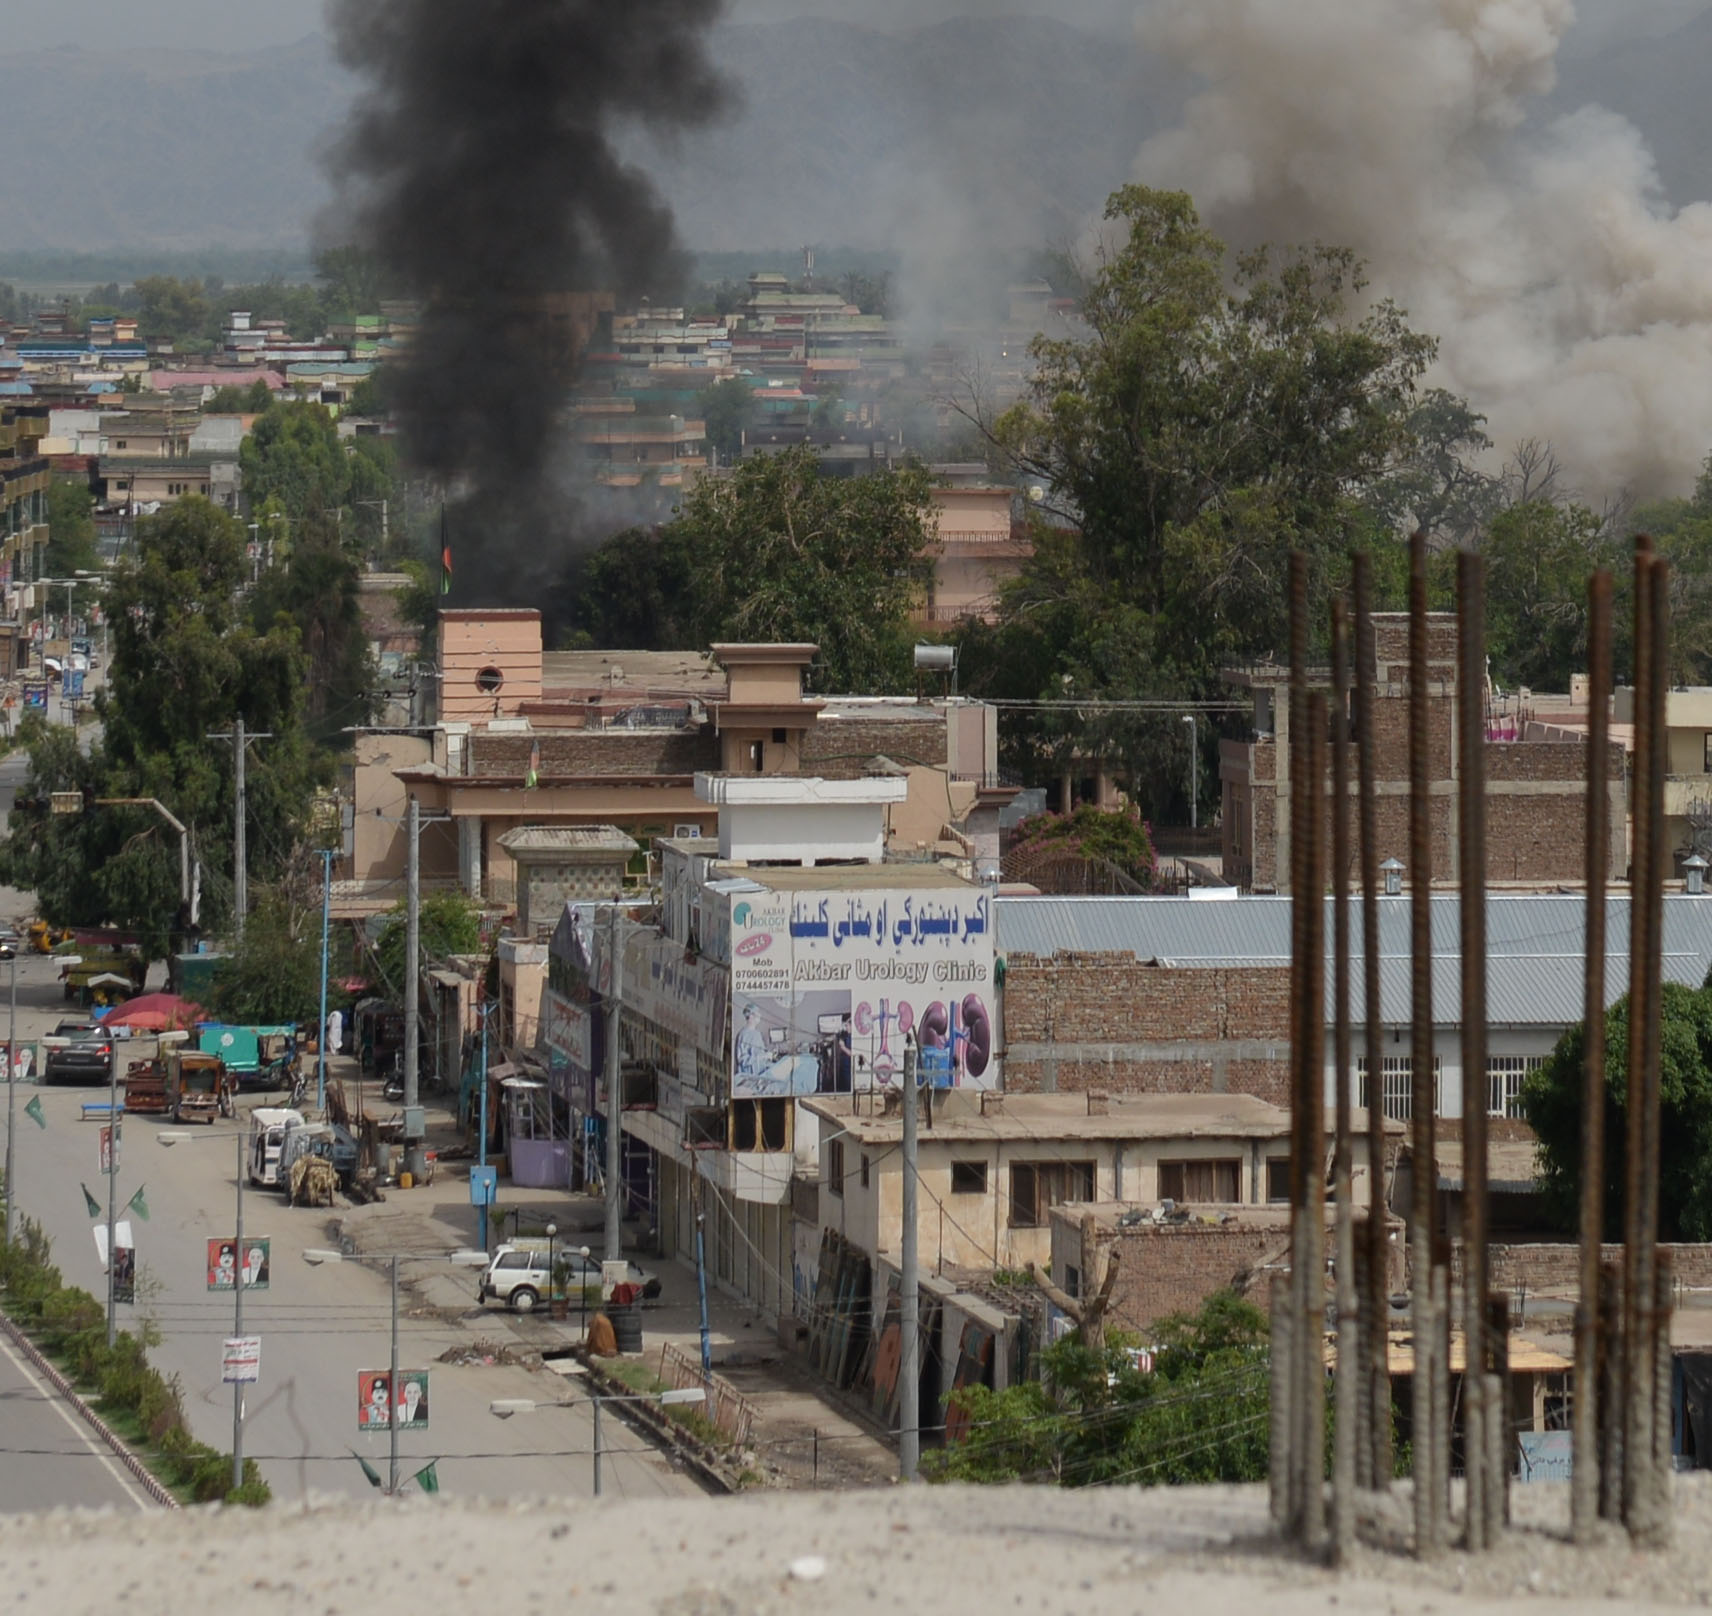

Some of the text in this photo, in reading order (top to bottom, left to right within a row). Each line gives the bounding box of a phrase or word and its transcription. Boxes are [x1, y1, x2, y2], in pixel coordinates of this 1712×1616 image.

[743, 912, 786, 929] UROLOGY
[876, 899, 887, 947] او
[752, 958, 773, 967] Mob
[793, 958, 987, 984] Akbar Urology Clinic
